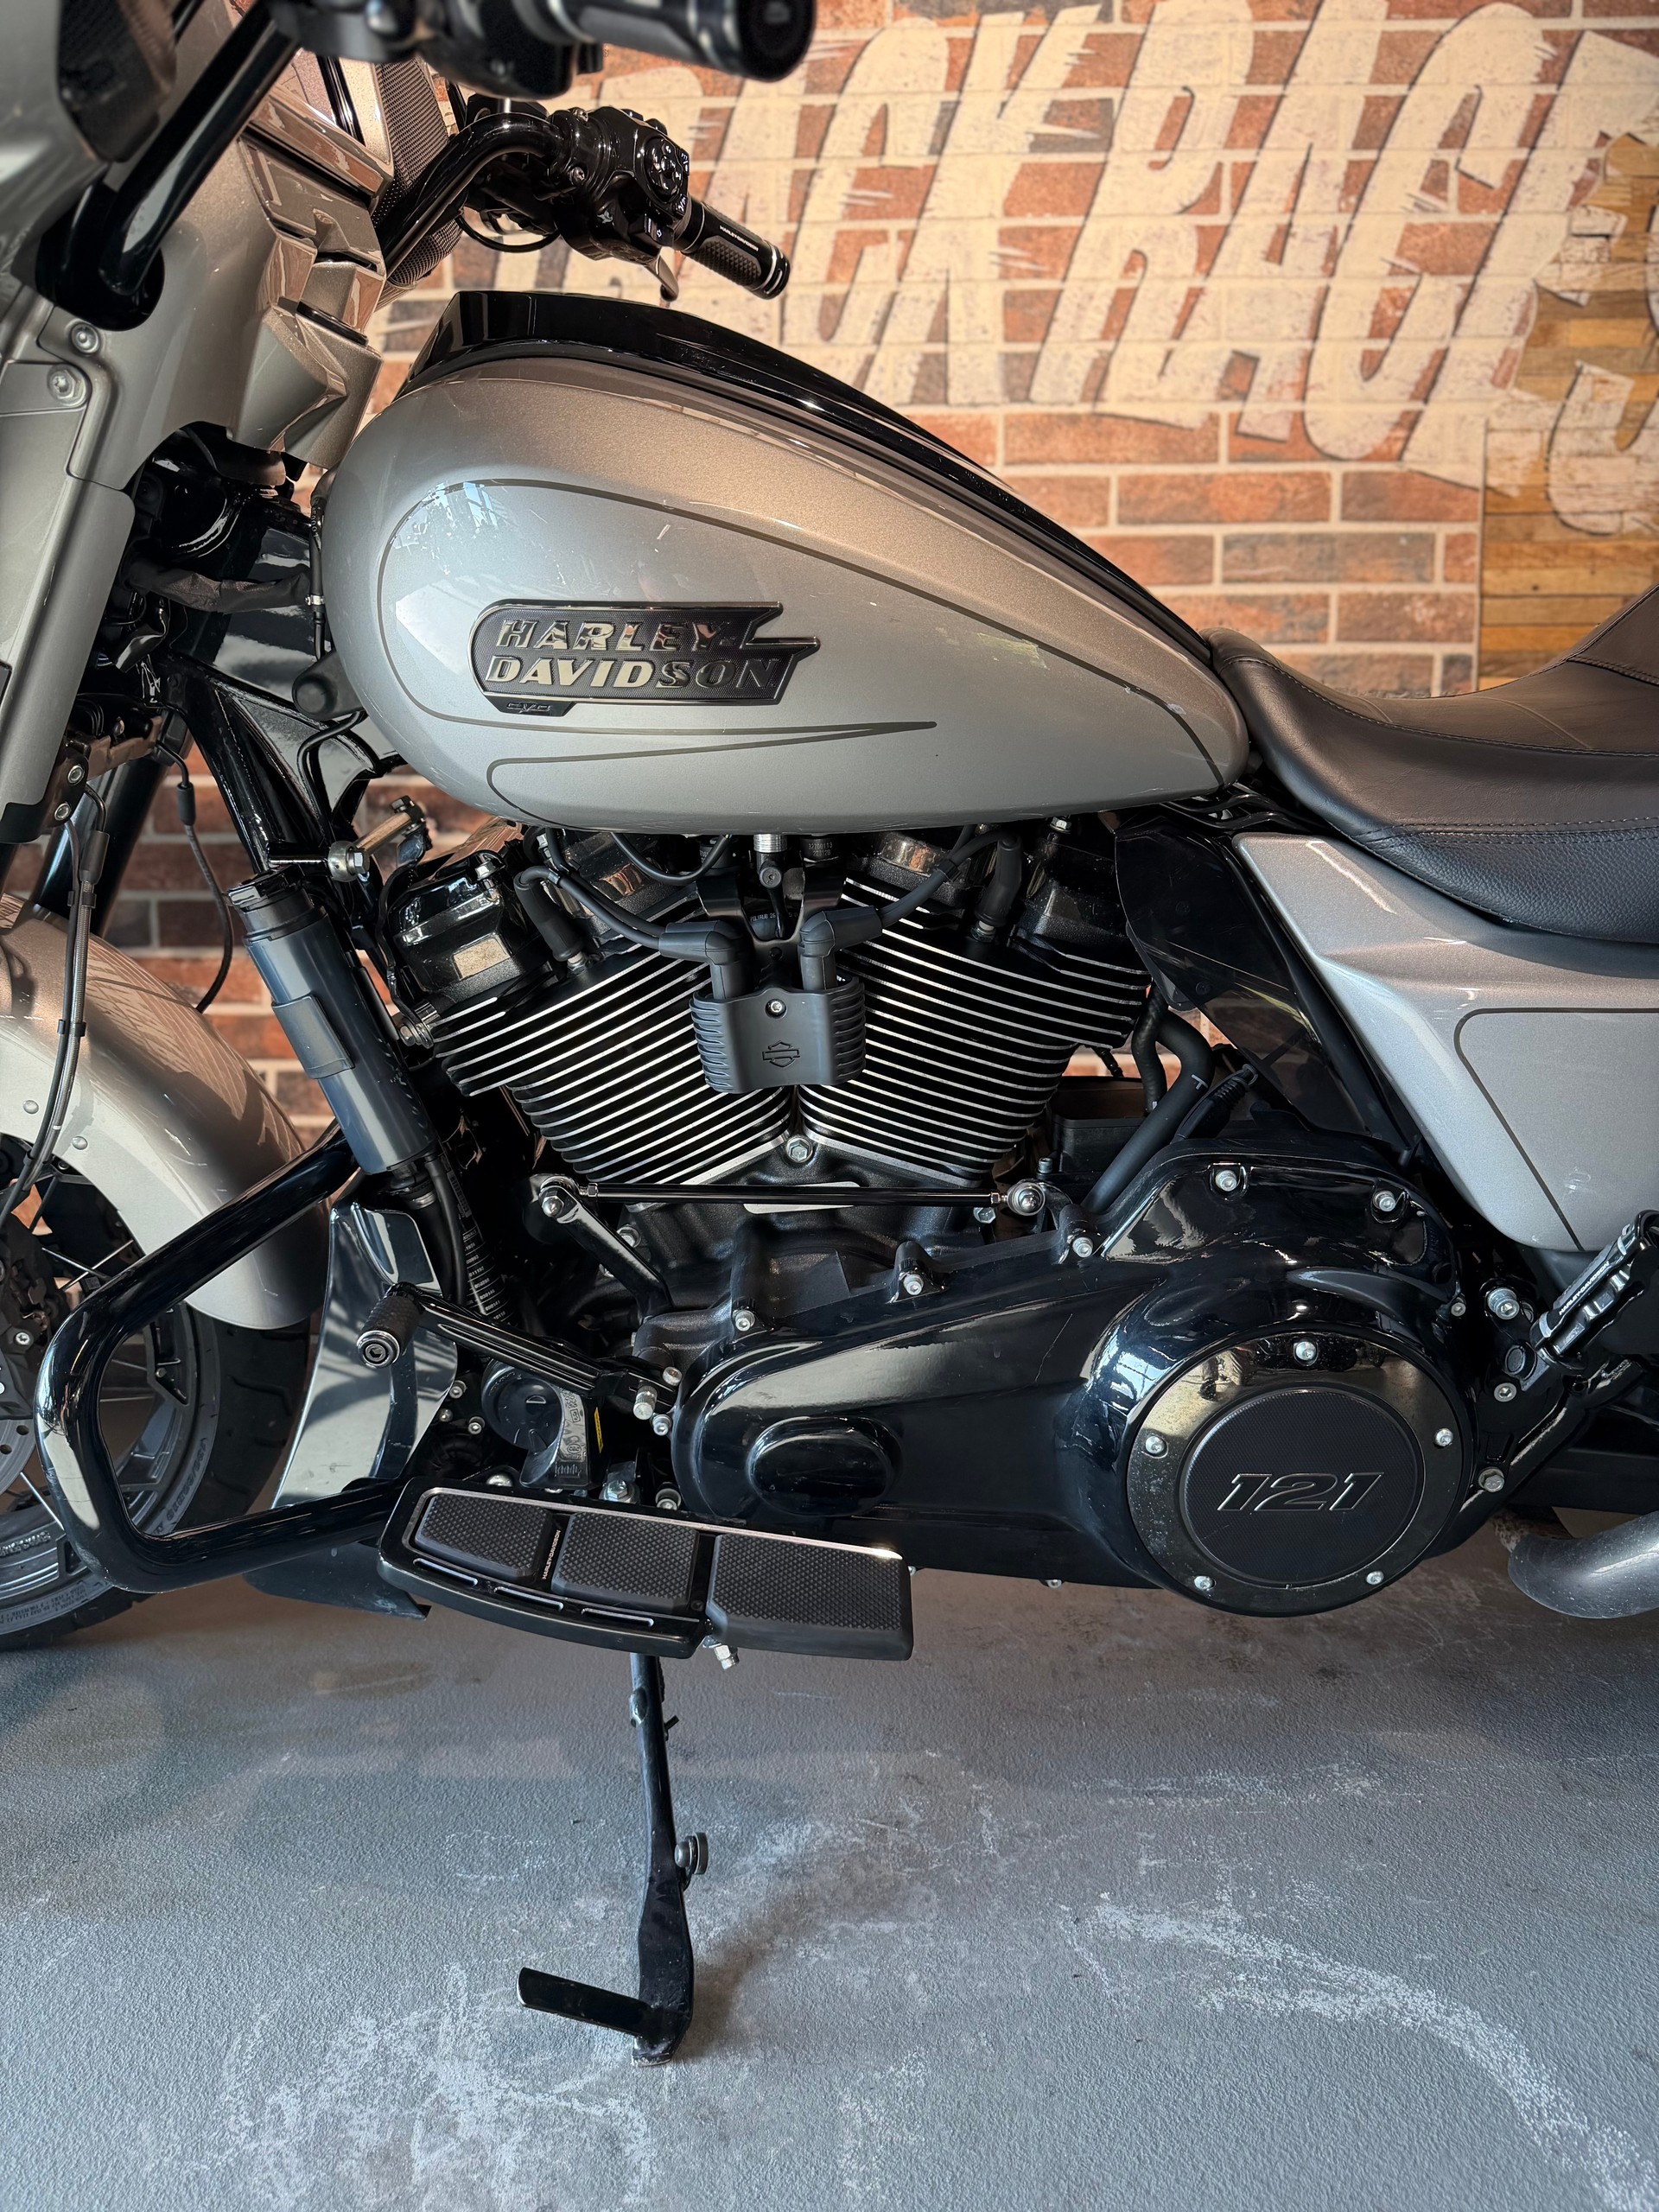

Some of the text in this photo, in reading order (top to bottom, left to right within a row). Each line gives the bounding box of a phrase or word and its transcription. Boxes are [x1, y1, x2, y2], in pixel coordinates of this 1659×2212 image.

[485, 655, 780, 690] DAVIDSON
[1559, 1260, 1610, 1316] HARLEY-DAVIDSON
[1217, 1471, 1384, 1512] 121
[542, 1529, 562, 1580] HARLEY-DAVIDSON
